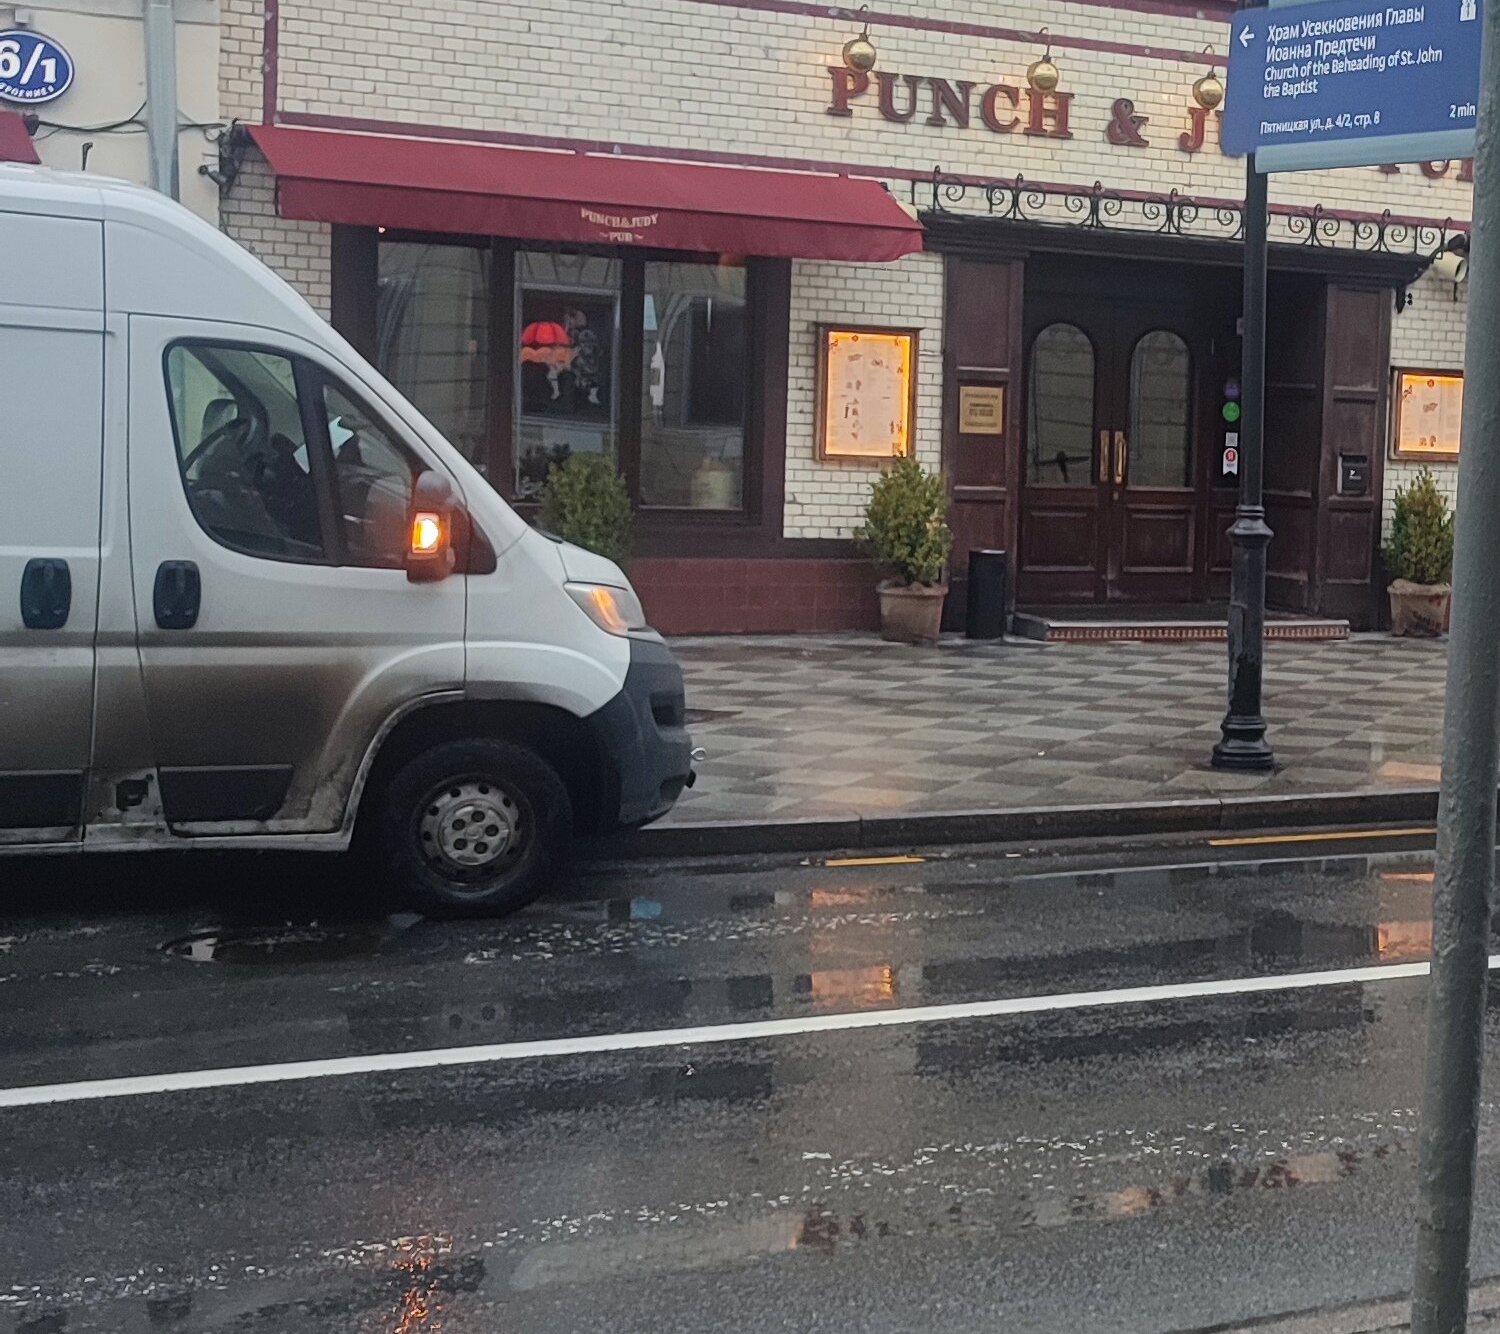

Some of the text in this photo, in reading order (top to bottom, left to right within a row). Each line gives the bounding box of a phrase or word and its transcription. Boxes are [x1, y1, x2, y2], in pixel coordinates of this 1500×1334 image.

[1267, 6, 1424, 45] Храм Усекновения Главы
[0, 39, 56, 85] 6/1
[1264, 46, 1442, 81] Church of the Beheading of St. John
[1266, 36, 1376, 62] Иоанна Предтечи
[1263, 79, 1318, 98] the Baptist
[826, 66, 1075, 139] PUNCH
[1107, 97, 1149, 147] &
[1449, 103, 1475, 117] 2 min
